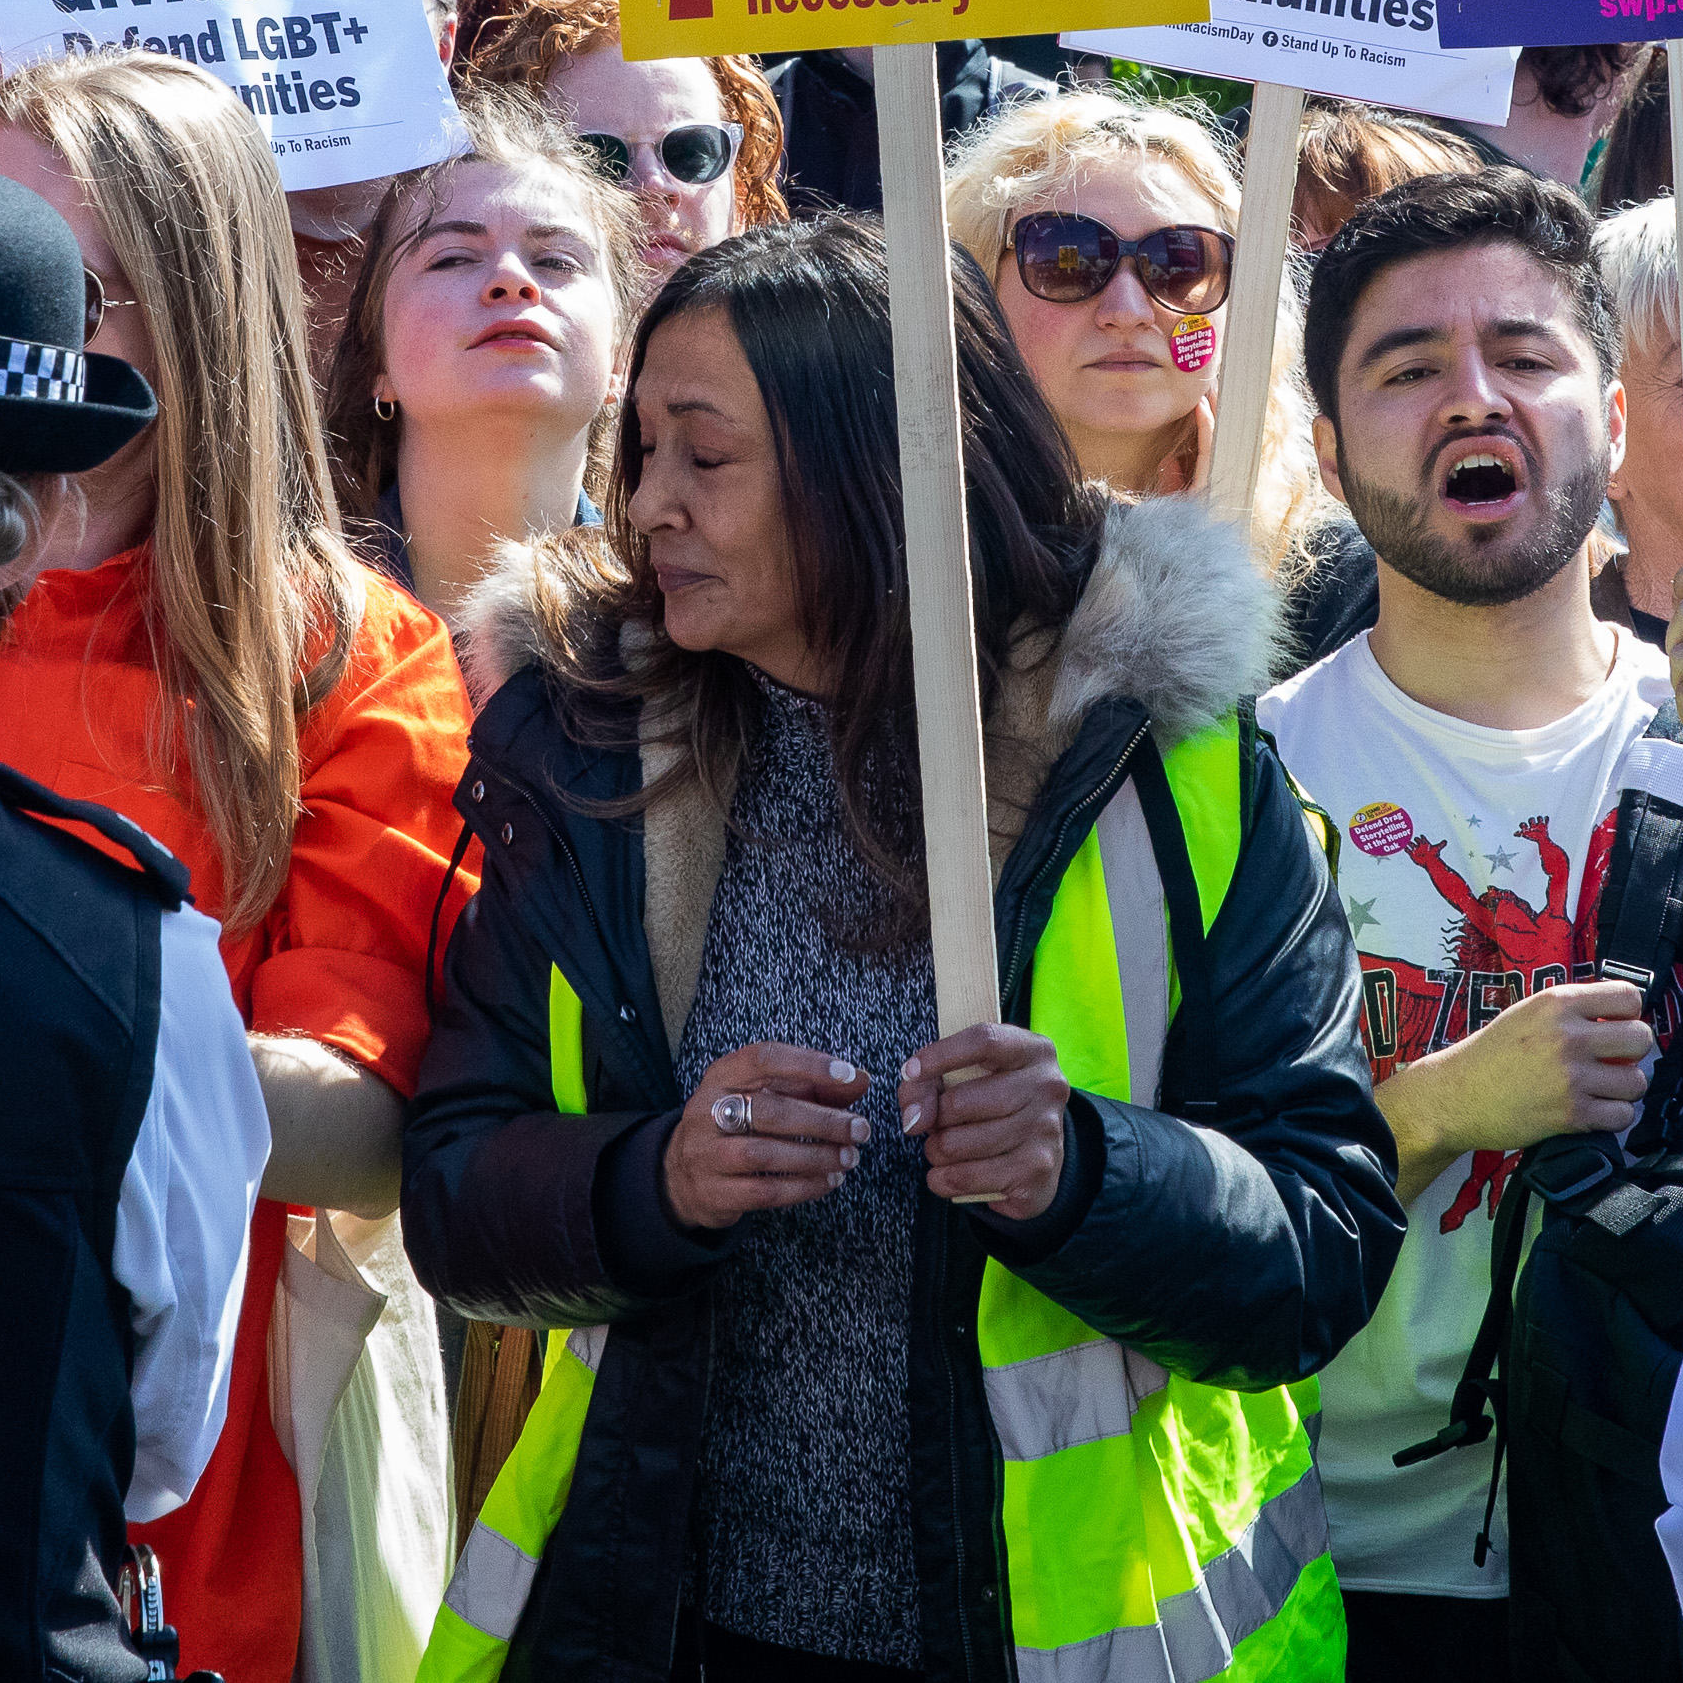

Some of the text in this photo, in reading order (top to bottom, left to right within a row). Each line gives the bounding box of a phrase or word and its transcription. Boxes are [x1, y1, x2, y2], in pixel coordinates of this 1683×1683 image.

[232, 12, 368, 60] LGBT+
[1281, 35, 1318, 52] Stand
[1322, 41, 1339, 57] Up
[1343, 44, 1357, 59] To
[1359, 48, 1406, 68] Racism
[241, 70, 362, 116] nities
[288, 139, 303, 153] To
[305, 133, 351, 152] Racism
[1354, 812, 1403, 834] Defend Drag
[1359, 821, 1407, 842] Storytelling
[1363, 829, 1411, 851] at the Honor
[1383, 843, 1400, 852] Oak
